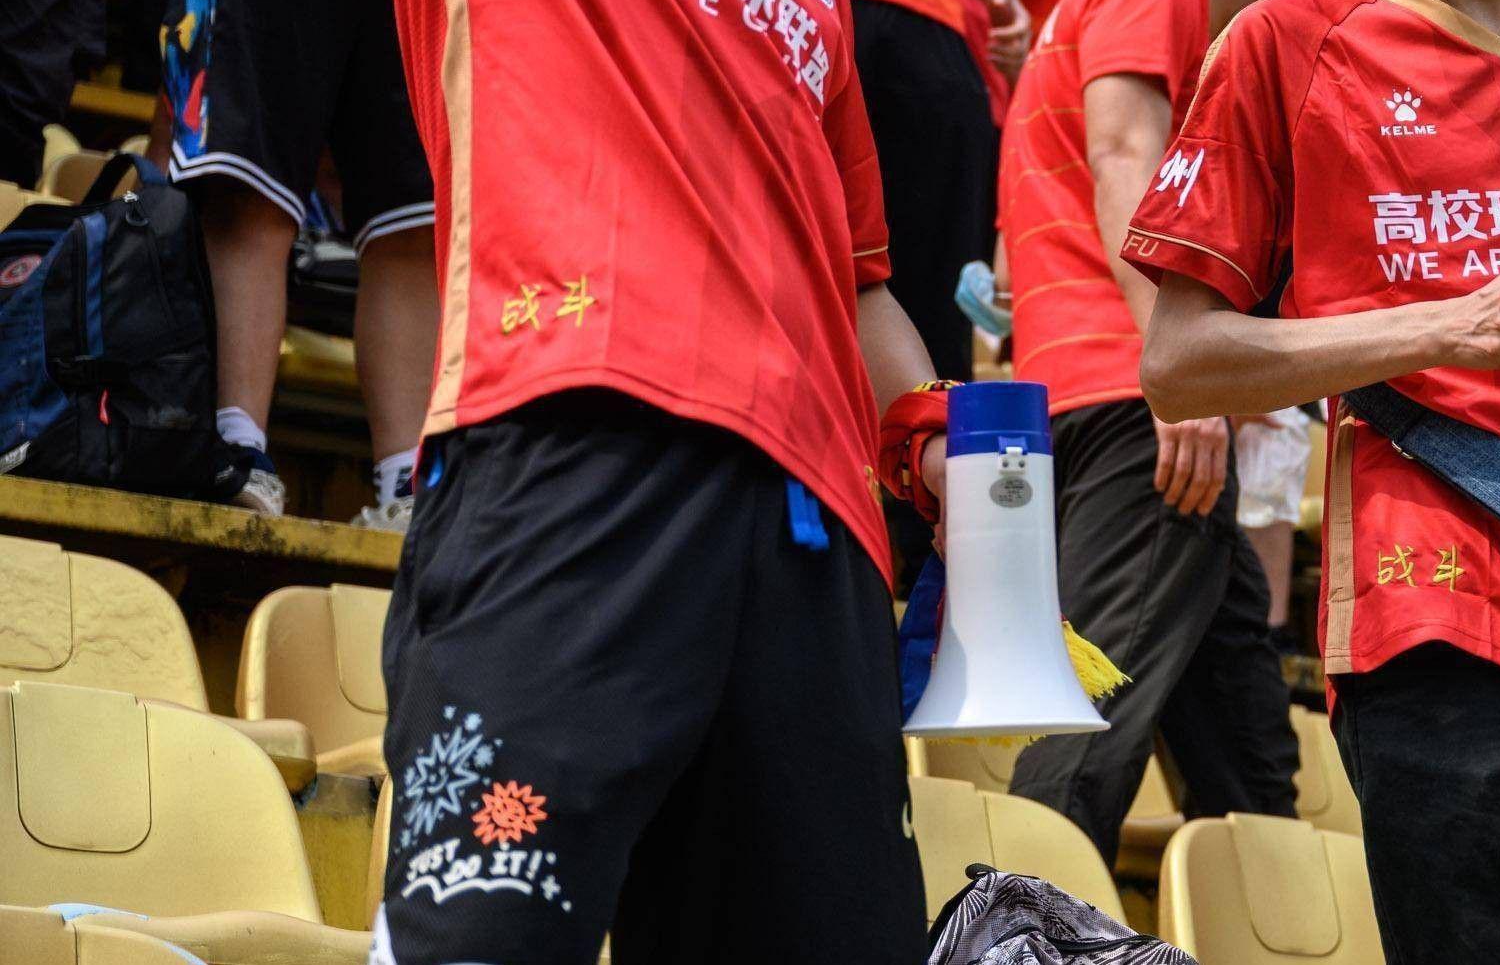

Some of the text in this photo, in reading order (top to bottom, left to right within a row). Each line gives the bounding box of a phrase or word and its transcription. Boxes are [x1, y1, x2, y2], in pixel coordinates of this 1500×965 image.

[1380, 124, 1438, 136] KELME
[1155, 148, 1205, 208] 州
[1123, 236, 1159, 257] FU
[1377, 251, 1443, 283] WE
[501, 274, 596, 334] 战斗
[1377, 543, 1465, 593] 战斗
[406, 838, 543, 886] JUST DO IT!
